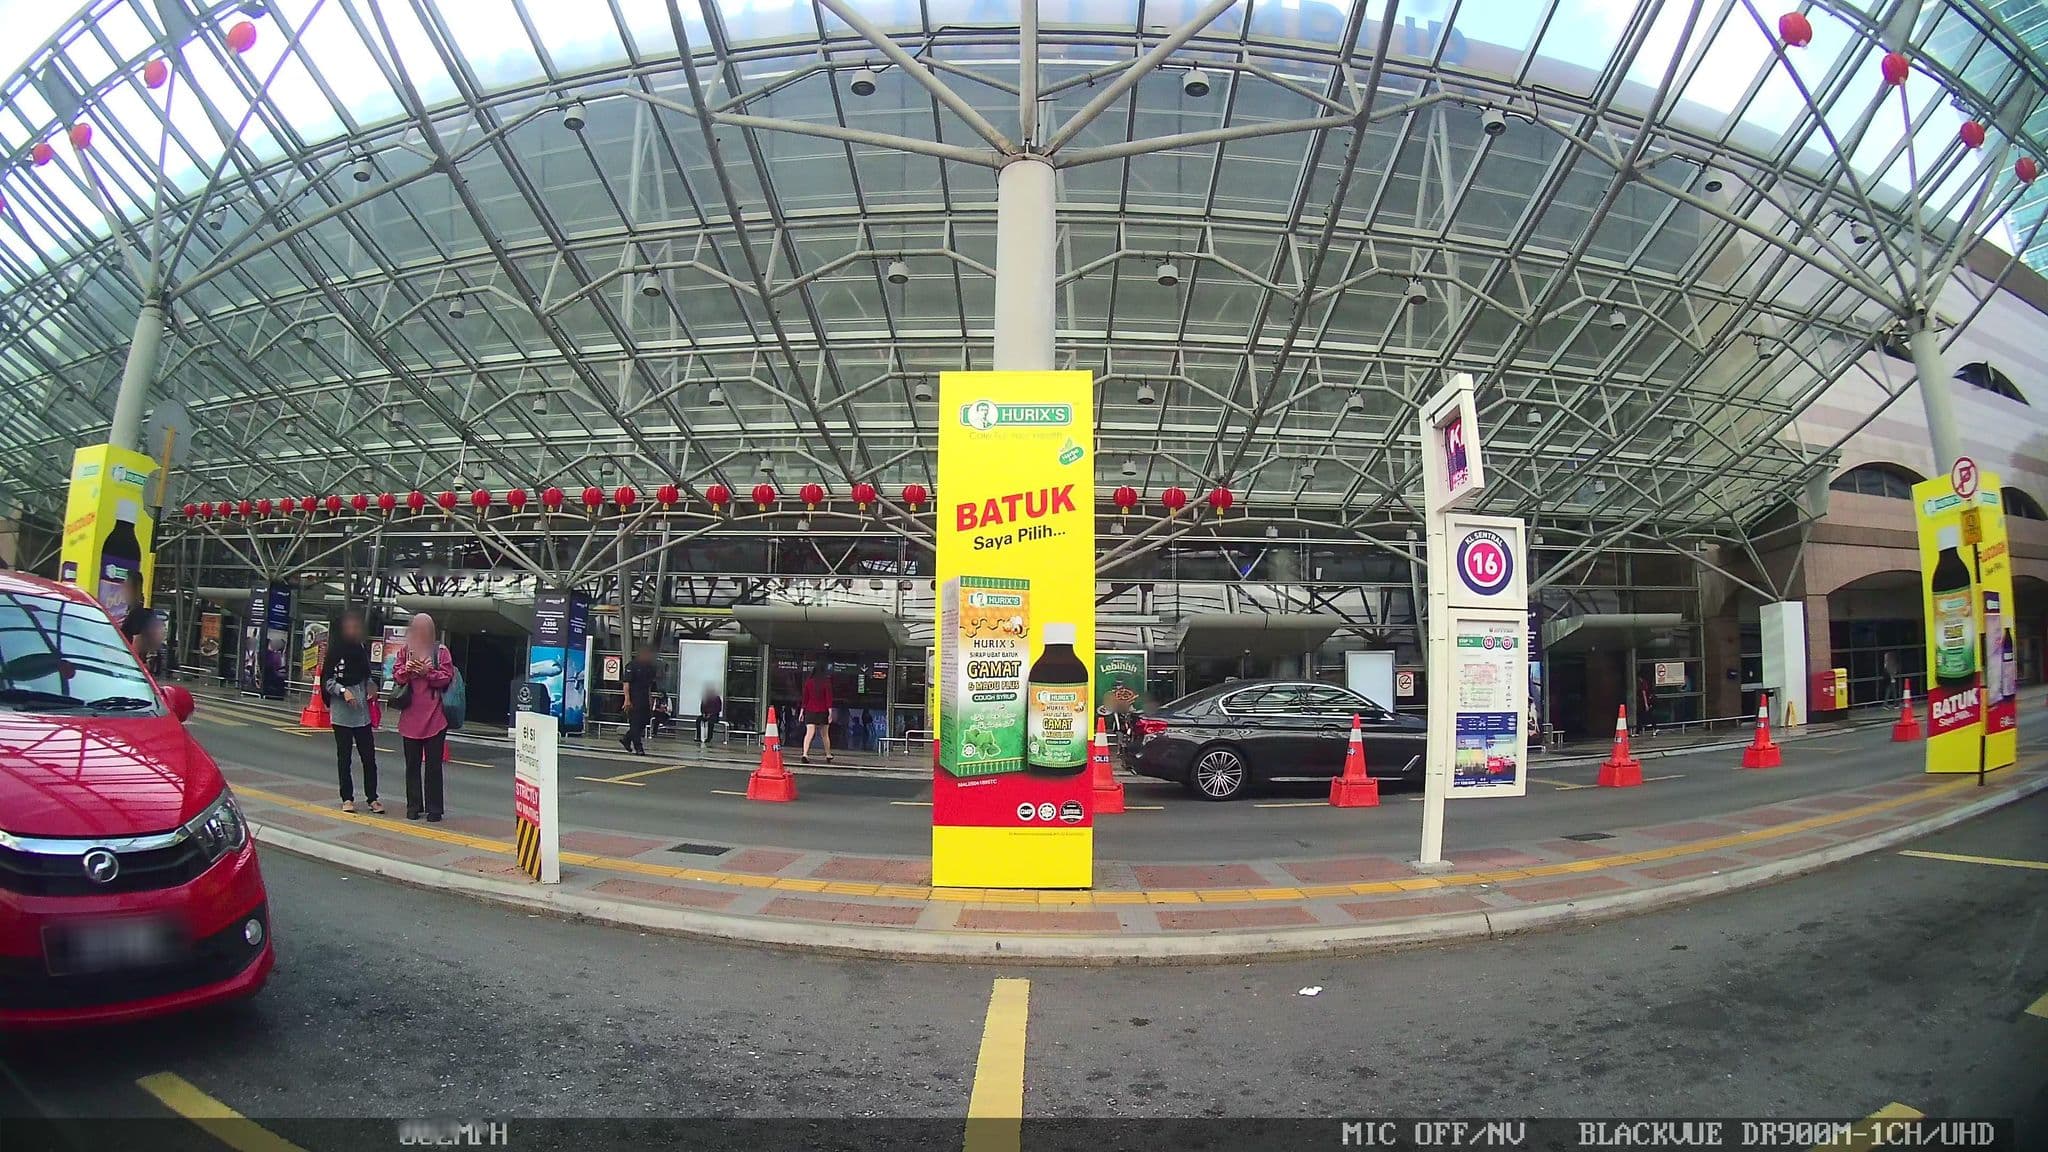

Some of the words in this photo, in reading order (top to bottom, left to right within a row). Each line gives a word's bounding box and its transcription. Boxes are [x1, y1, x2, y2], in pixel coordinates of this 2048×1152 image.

[1002, 408, 1066, 422] HURIX'S
[956, 484, 1076, 532] BATUK
[973, 535, 1012, 551] Saya
[1018, 524, 1066, 543] Pilih...
[1464, 535, 1474, 545] KL
[1473, 531, 1503, 547] SENTRAL
[1472, 551, 1498, 576] 16
[988, 596, 1019, 605] HURIX'S
[967, 660, 1021, 679] GAMAT
[975, 681, 1000, 691] MADU
[1933, 687, 1979, 719] BATUK
[1043, 718, 1073, 730] GAMAT
